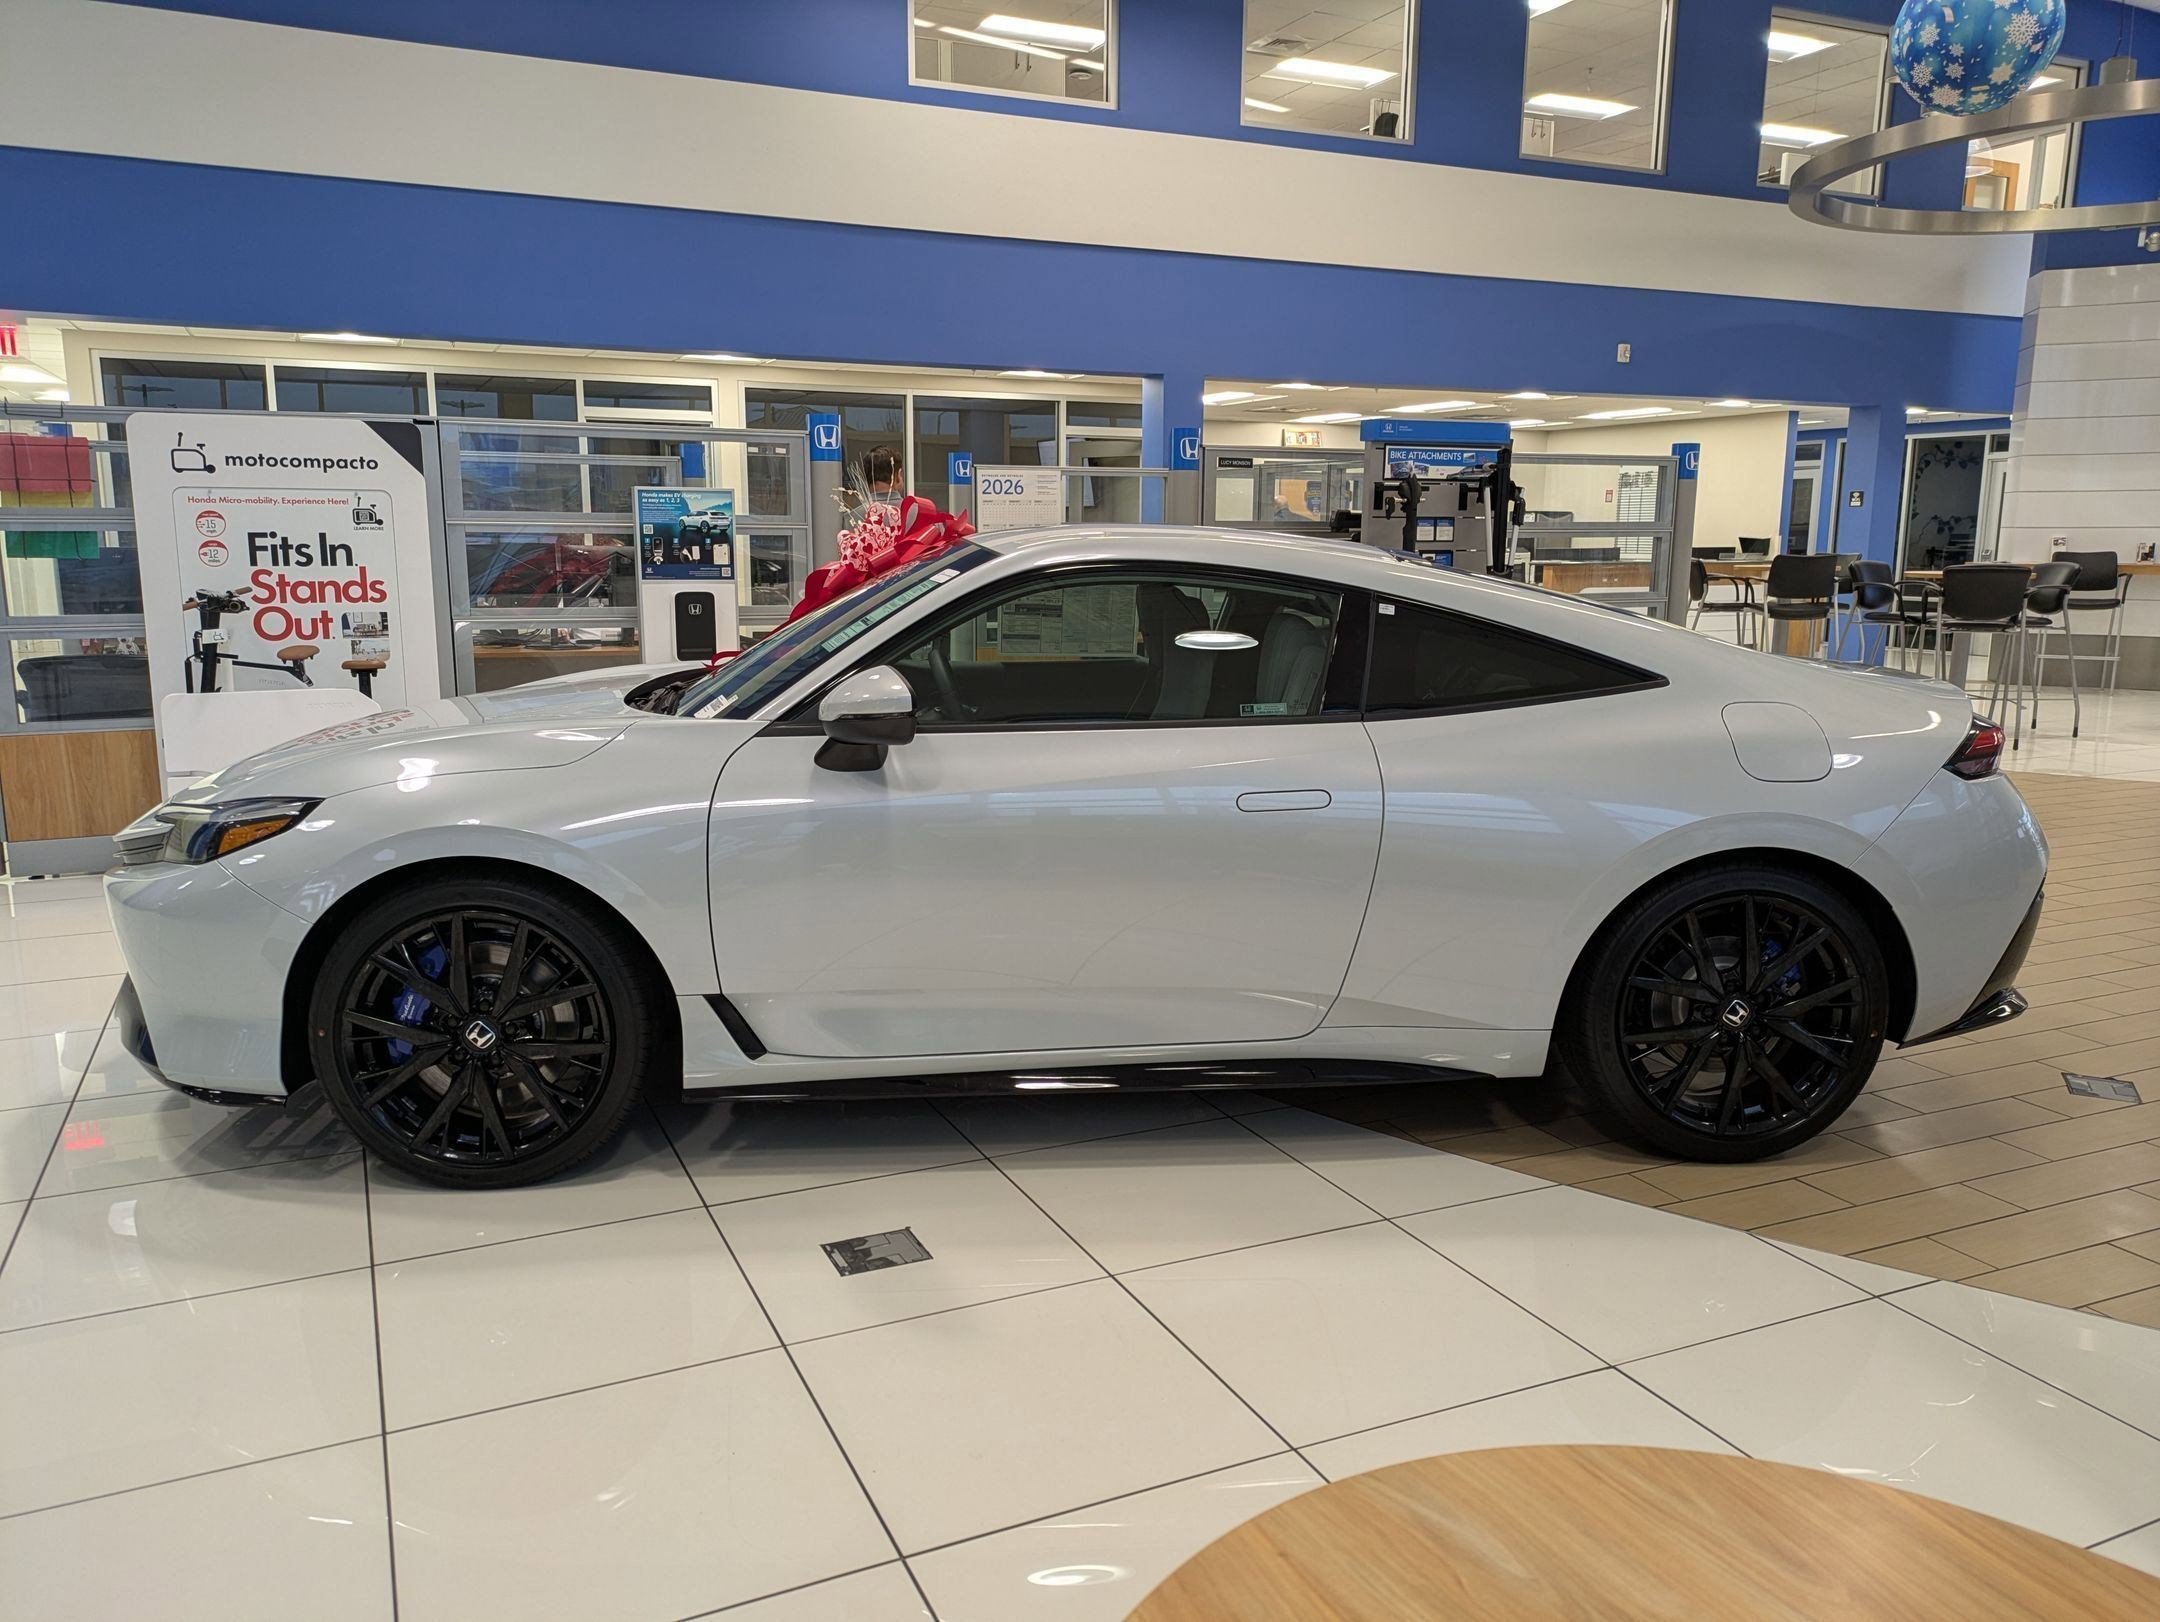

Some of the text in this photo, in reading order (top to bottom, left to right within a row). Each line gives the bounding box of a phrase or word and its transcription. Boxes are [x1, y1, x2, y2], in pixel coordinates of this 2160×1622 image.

[225, 453, 378, 473] motocompacto
[1390, 450, 1461, 461] BIKE ATTACHMENTS
[982, 479, 1024, 495] 2026
[187, 496, 216, 504] Honda
[218, 496, 280, 506] Micro-mobility.
[281, 497, 325, 506] Experience
[205, 519, 216, 529] 15
[208, 549, 219, 558] 12
[247, 531, 358, 567] Fits In.
[250, 566, 388, 605] Stands
[253, 605, 336, 642] Out.
